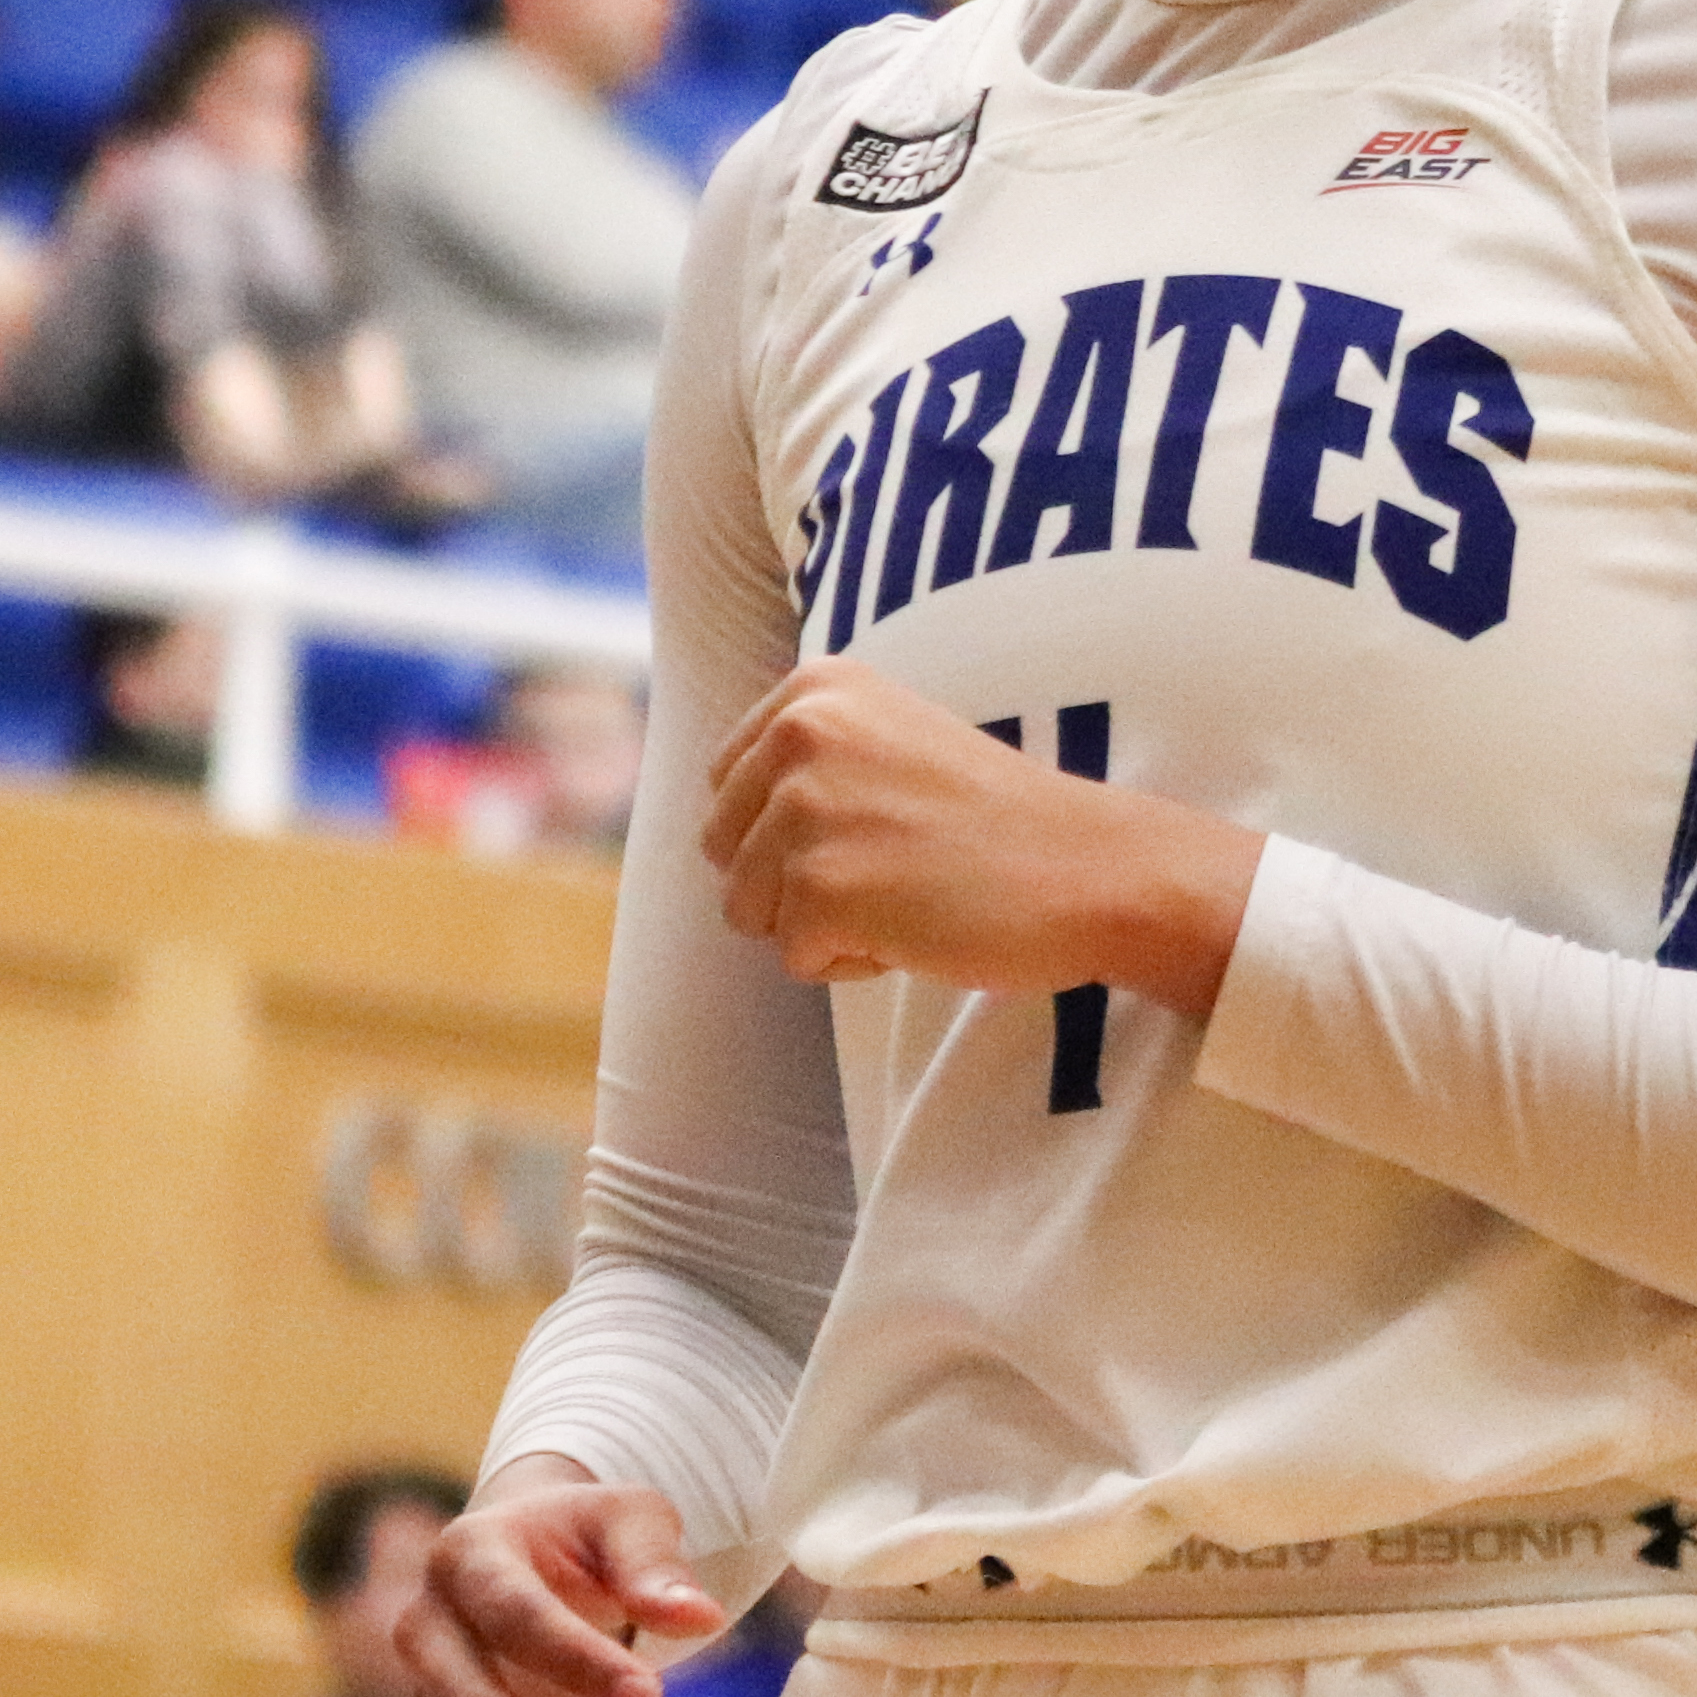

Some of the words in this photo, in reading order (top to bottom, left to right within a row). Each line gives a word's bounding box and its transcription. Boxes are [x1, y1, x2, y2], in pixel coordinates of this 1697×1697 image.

[1359, 128, 1469, 155] BIG
[1334, 158, 1491, 181] EAST
[794, 274, 1535, 656] PIRATES
[1366, 1519, 1605, 1566] UNDER
